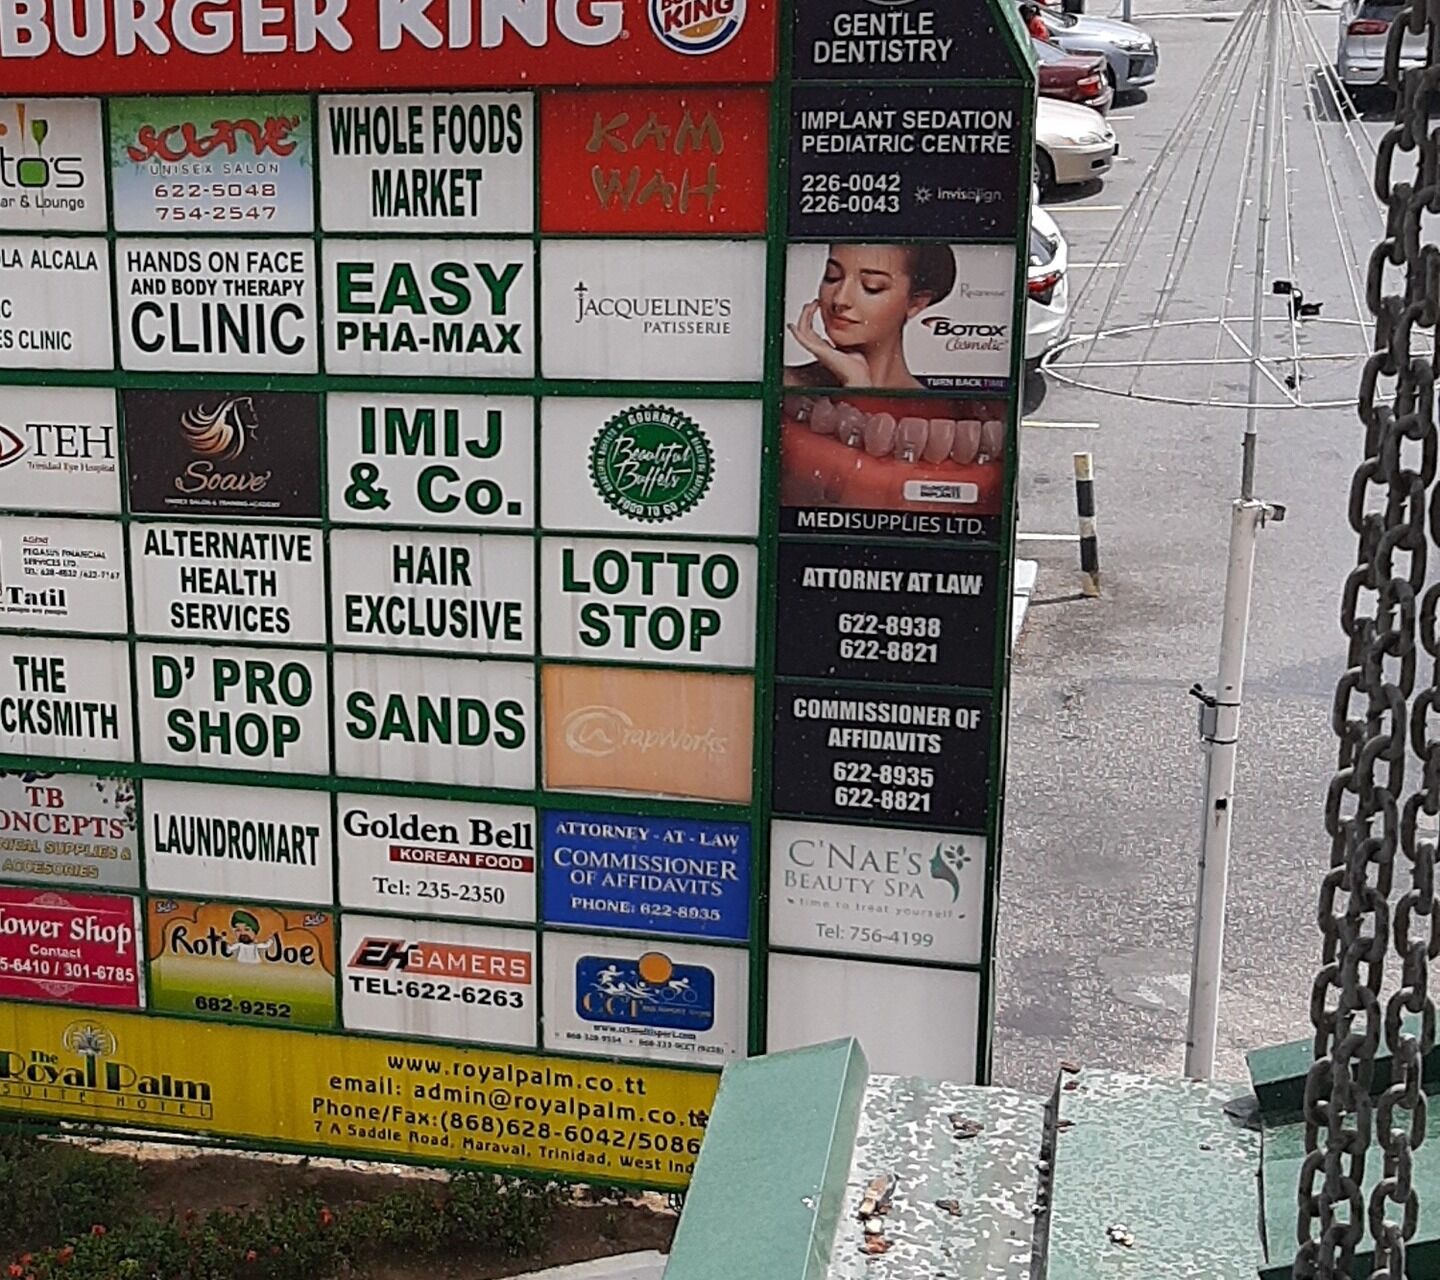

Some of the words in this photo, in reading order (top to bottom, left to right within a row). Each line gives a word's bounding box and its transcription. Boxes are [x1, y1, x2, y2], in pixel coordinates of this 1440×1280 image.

[834, 12, 934, 36] GENTLE
[813, 38, 952, 63] DENTISTRY
[329, 105, 424, 156] WHOLE
[433, 104, 523, 155] FOODS
[586, 111, 724, 155] KAM
[801, 111, 896, 130] IMPLANT
[902, 110, 1012, 130] SEDATION
[802, 135, 914, 153] PEDIATRIC
[921, 134, 1011, 153] CENTRE
[150, 164, 212, 175] UNISEX
[224, 163, 279, 174] SALON
[155, 184, 276, 197] 622-5048
[371, 168, 483, 218] MARKET
[592, 164, 720, 213] WAH
[802, 174, 901, 193] 226-0042
[20, 196, 30, 208] &
[36, 196, 84, 211] Lounge
[156, 207, 276, 220] 754-2547
[801, 195, 900, 213] 226-0043
[31, 250, 98, 271] ALCALA
[127, 251, 201, 273] HANDS
[208, 251, 239, 272] ON
[247, 252, 304, 273] FACE
[131, 279, 167, 295] AND
[172, 279, 217, 296] BODY
[223, 279, 305, 297] THERAPY
[336, 262, 524, 316] EASY
[19, 330, 72, 351] CLINIC
[131, 301, 306, 355] CLINIC
[336, 321, 522, 354] PHA-MAX
[643, 321, 731, 334] PATISSERIE
[933, 321, 1008, 337] BOTOX
[927, 378, 953, 386] TURN
[360, 406, 502, 459] IMIJ
[627, 411, 685, 430] GOURMET
[26, 424, 115, 458] TEH
[175, 460, 272, 494] Soave
[344, 462, 391, 511] &
[417, 465, 521, 515] Co.
[798, 510, 941, 533] MEDISUPPLIES
[946, 517, 985, 534] LTD.
[144, 528, 312, 563] ALTERNATIVE
[392, 544, 471, 586] HAIR
[561, 548, 739, 599] LOTTO
[181, 566, 277, 597] HEALTH
[802, 567, 903, 591] ATTORNEY
[907, 572, 932, 593] AT
[935, 574, 983, 596] LAW
[6, 587, 66, 607] Tatil
[170, 602, 291, 633] SERVICES
[345, 594, 523, 641] EXCLUSIVE
[579, 602, 721, 652] STOP
[838, 614, 941, 638] 622-8938
[840, 639, 937, 663] 622-8821
[14, 656, 66, 694] THE
[152, 655, 194, 699] D'
[213, 659, 312, 707] PRO
[346, 691, 525, 749] SANDS
[793, 698, 950, 727] COMMISSIONER
[955, 709, 981, 730] OF
[167, 708, 301, 758] SHOP
[828, 727, 942, 754] AFFIDAVITS
[834, 761, 934, 788] 622-8935
[25, 786, 65, 809] TB
[835, 787, 931, 812] 622-8821
[154, 814, 320, 866] LAUNDROMART
[343, 809, 459, 845] Golden
[469, 818, 533, 850] Bell
[555, 822, 650, 841] ATTORNEY
[663, 830, 684, 844] AT
[699, 833, 740, 848] LAW
[399, 848, 470, 865] KOREAN
[475, 853, 523, 870] FOOD
[554, 847, 739, 881] COMMISSIONER
[789, 839, 922, 875] C'NAE'S
[372, 877, 411, 896] Tel:
[417, 880, 505, 904] 235-2350
[570, 870, 596, 885] OF
[602, 873, 722, 897] AFFIDAVITS
[784, 870, 875, 895] BEAUTY
[884, 878, 925, 899] SPA
[570, 896, 635, 913] PHONE:
[70, 916, 132, 954] Shop
[171, 926, 233, 957] Roti
[265, 932, 316, 965] Joe
[816, 923, 844, 940] Tel:
[850, 926, 933, 947] 756-4199
[29, 943, 81, 959] Contact
[64, 962, 134, 982] 301-6785
[195, 996, 291, 1017] 682-9252
[31, 1050, 59, 1064] The
[106, 1062, 211, 1101] Palm
[387, 1054, 646, 1096] www.royalpalm.co.tt
[1, 1083, 86, 1103] SUITE
[116, 1096, 204, 1116] HOTEL
[329, 1076, 402, 1096] email:
[413, 1083, 708, 1128] admin@royalpalm.co.tt
[314, 1120, 322, 1133] 7
[330, 1123, 341, 1136] A
[347, 1124, 402, 1142] Saddle
[620, 1154, 661, 1171] West
